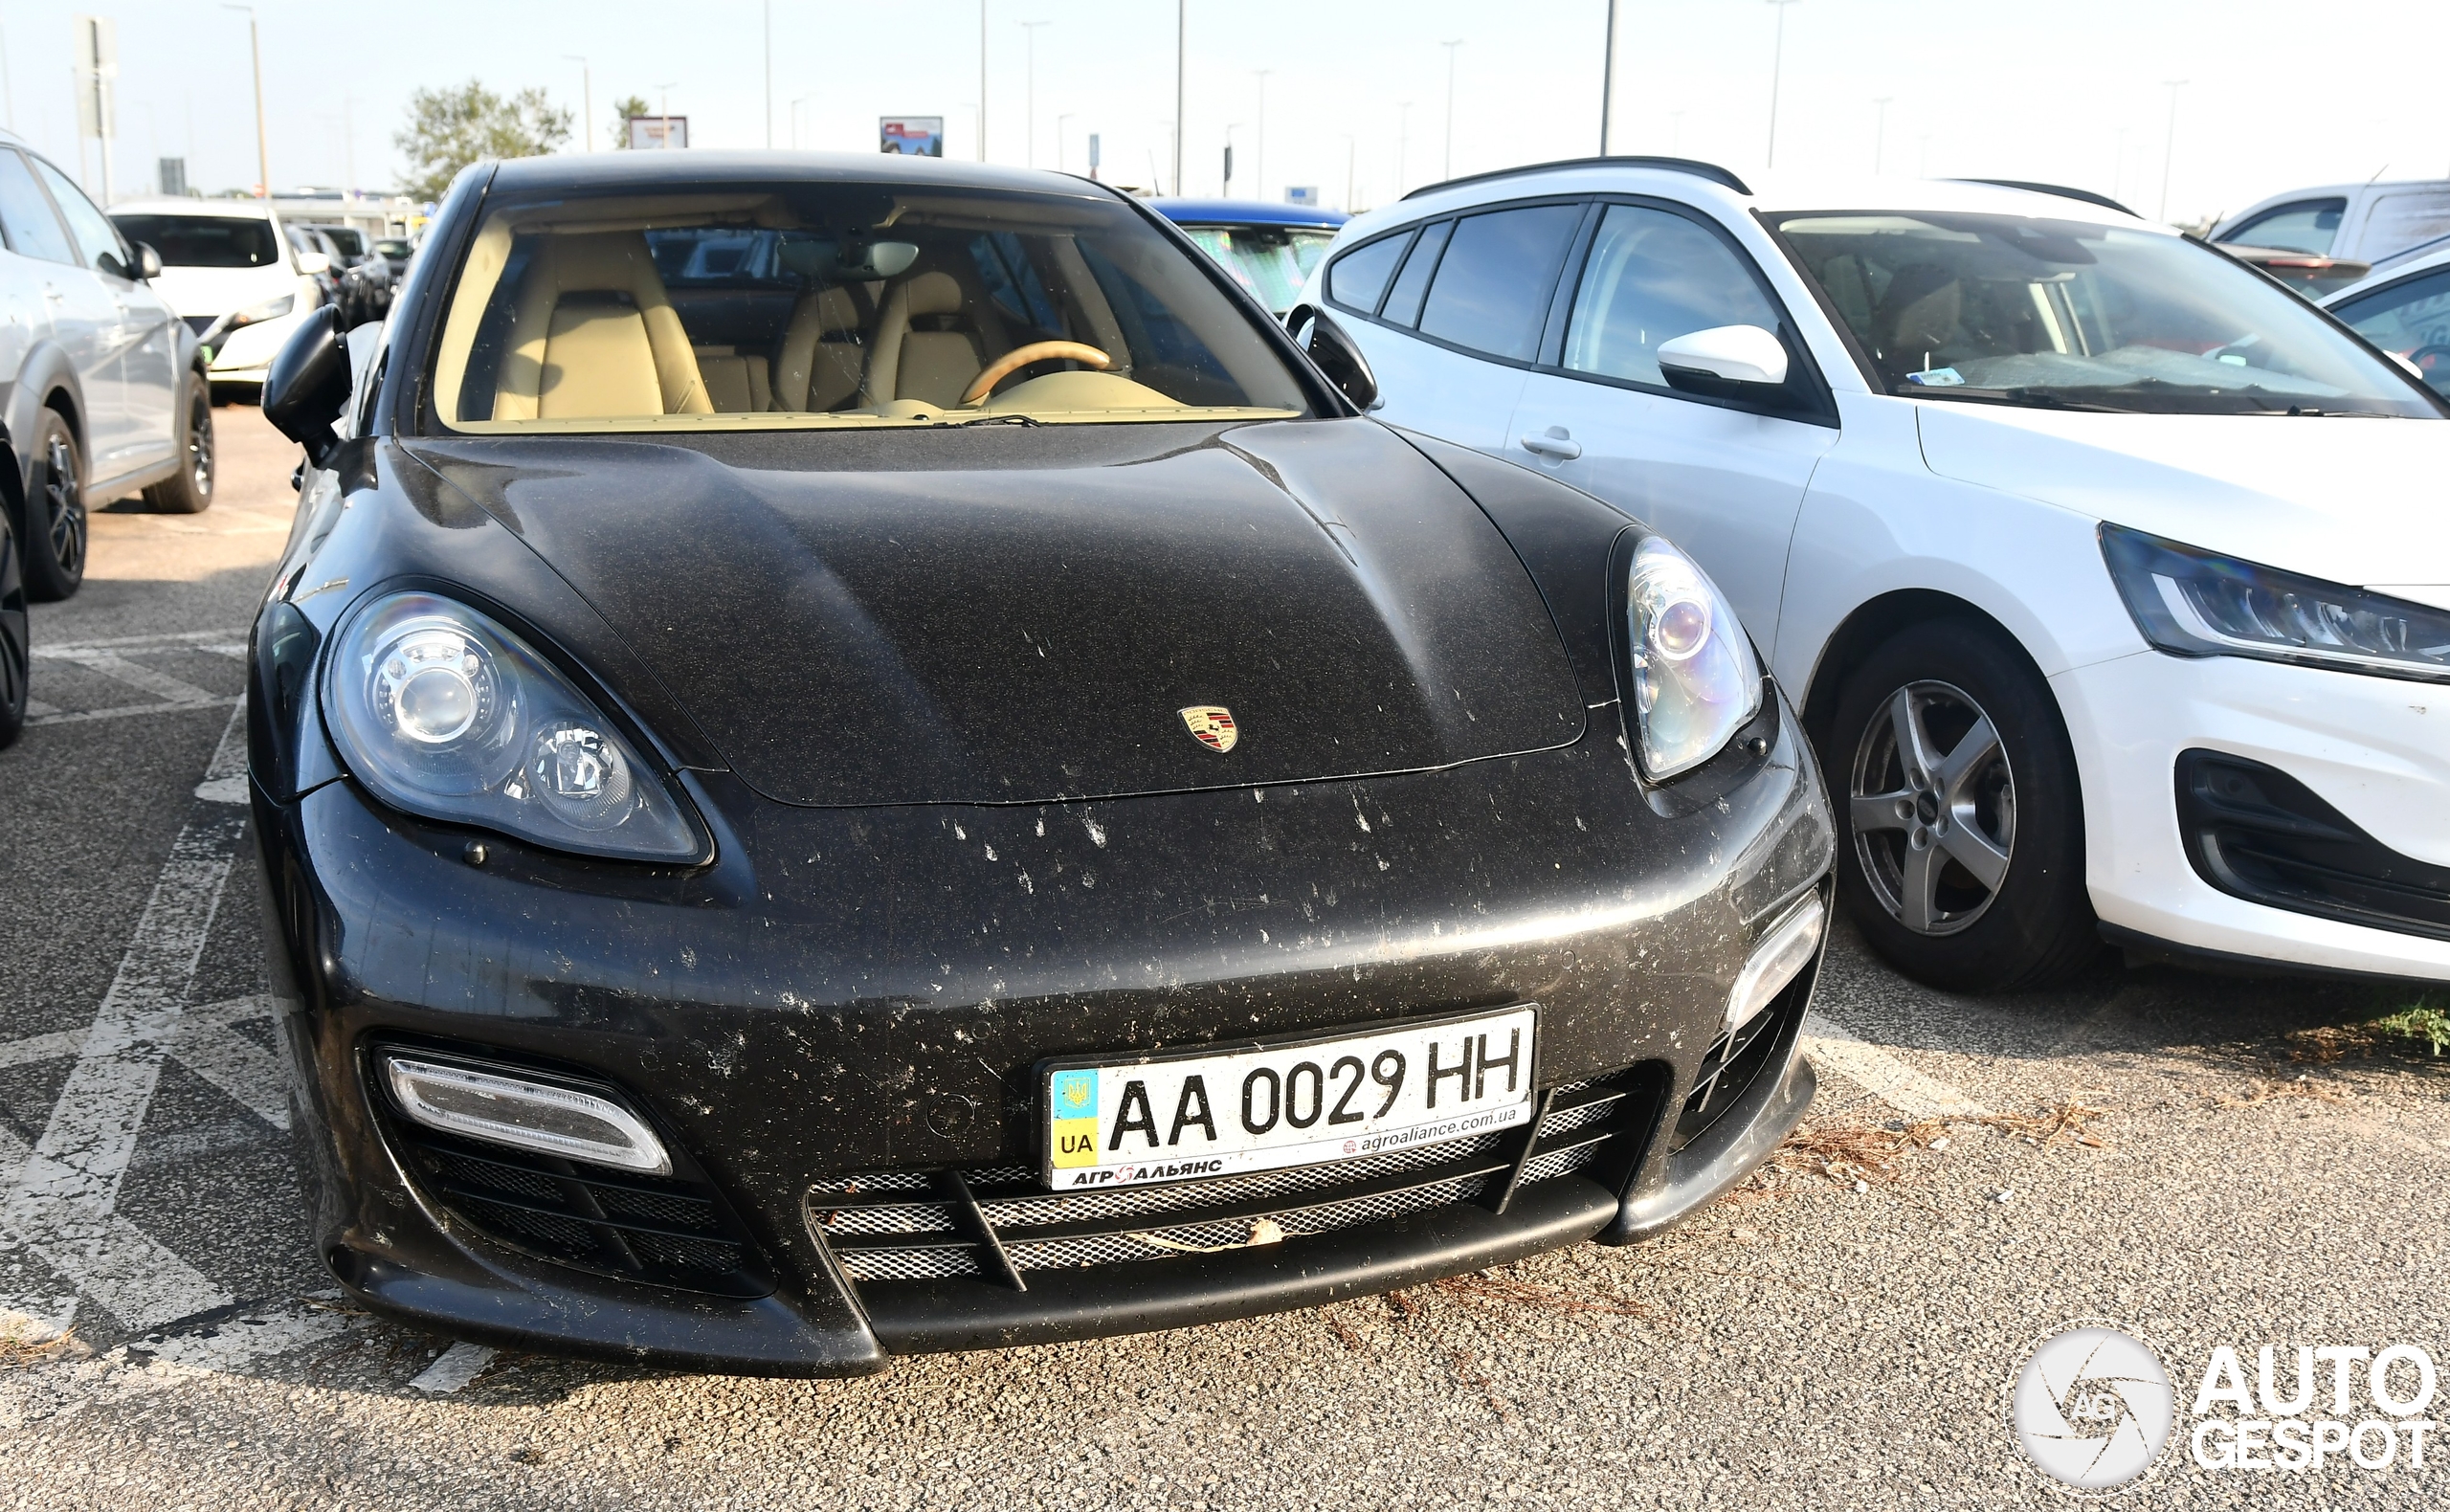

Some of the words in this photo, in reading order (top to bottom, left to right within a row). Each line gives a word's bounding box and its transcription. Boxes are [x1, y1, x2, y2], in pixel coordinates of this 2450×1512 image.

[1108, 1075, 1217, 1151] AA
[1241, 1049, 1407, 1135] 0029
[1427, 1027, 1520, 1109] HH
[1060, 1134, 1093, 1154] UA
[1361, 1108, 1517, 1152] agroaliance.com.ua
